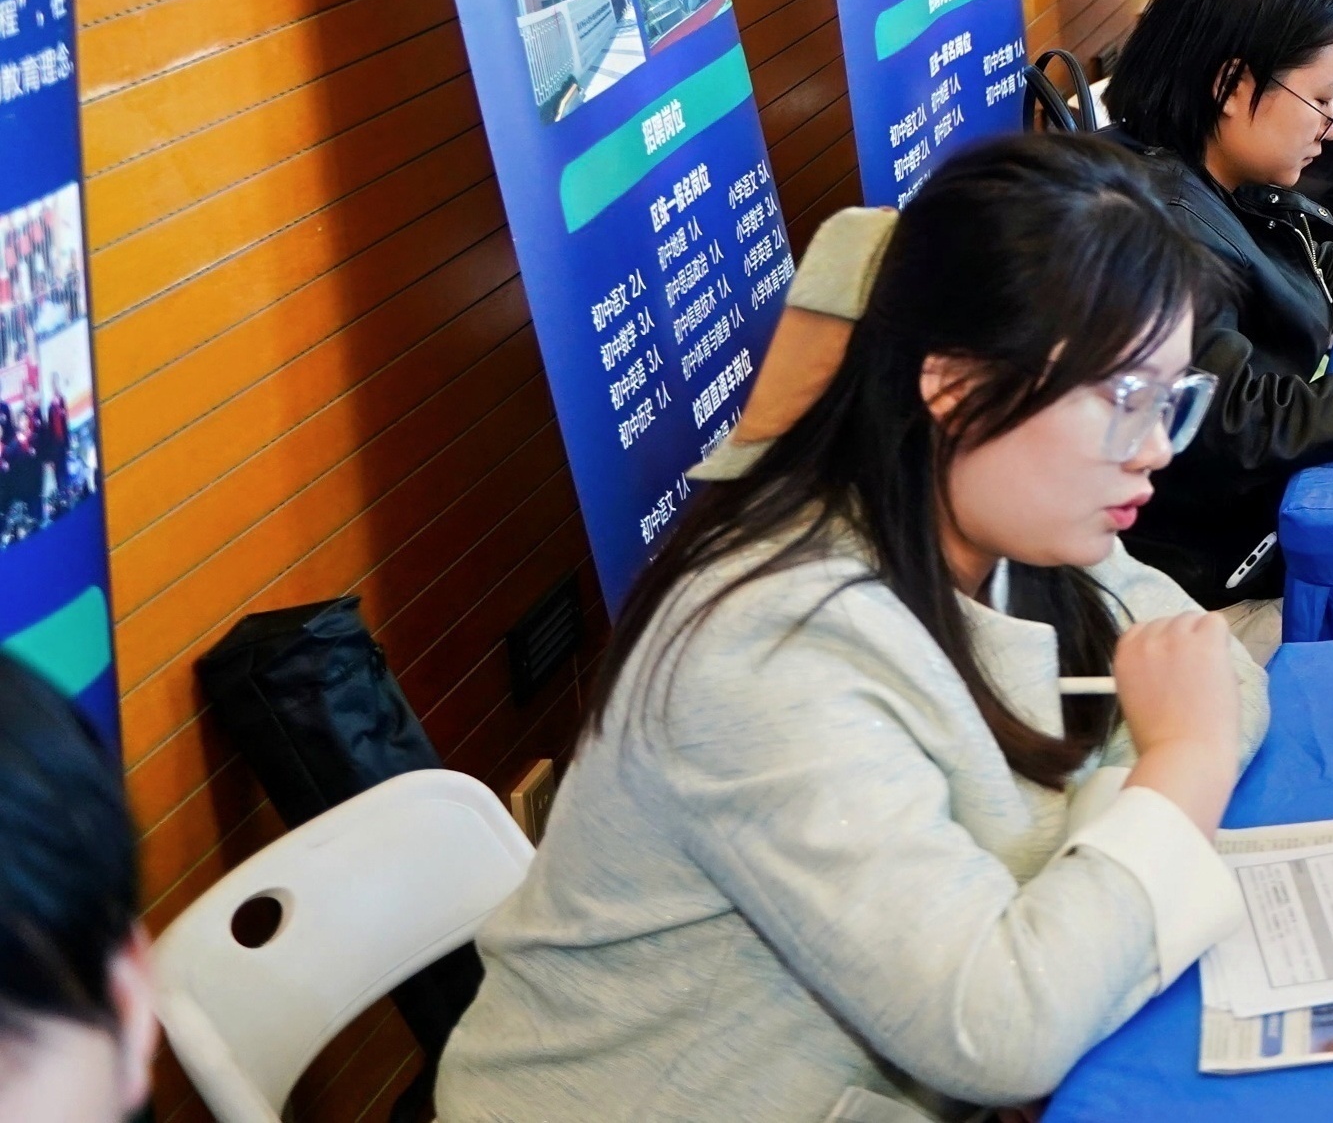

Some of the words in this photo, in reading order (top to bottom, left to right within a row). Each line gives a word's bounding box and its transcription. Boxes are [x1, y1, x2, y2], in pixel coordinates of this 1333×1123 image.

[642, 98, 686, 156] 招聘岗位
[649, 163, 712, 234] 区统一报名岗位
[728, 170, 758, 210] 小学语文
[757, 159, 770, 183] 5人
[735, 202, 765, 244] 小学数学
[764, 191, 778, 216] 3人
[656, 225, 689, 272] 初中地理
[687, 215, 703, 242] 1人
[664, 250, 710, 309] 初中思品政治
[709, 238, 724, 266] 1人
[743, 234, 773, 277] 小学英语
[772, 224, 786, 249] 2人
[591, 283, 630, 333] 初中语文
[628, 267, 647, 298] 2人
[672, 286, 717, 345] 初中信息技术
[716, 273, 732, 300] 1人
[600, 320, 637, 372] 初中数学
[636, 305, 656, 336] 3人
[680, 314, 731, 381] 初中体育与健身
[730, 302, 745, 329] 1人
[609, 358, 647, 411] 初中英语
[645, 344, 664, 374] 3人
[691, 347, 754, 431] 校园直通车岗位
[618, 397, 656, 450] 初中历史
[655, 380, 672, 412] 1人
[640, 490, 677, 545] 初中语文
[675, 472, 691, 502] 1人
